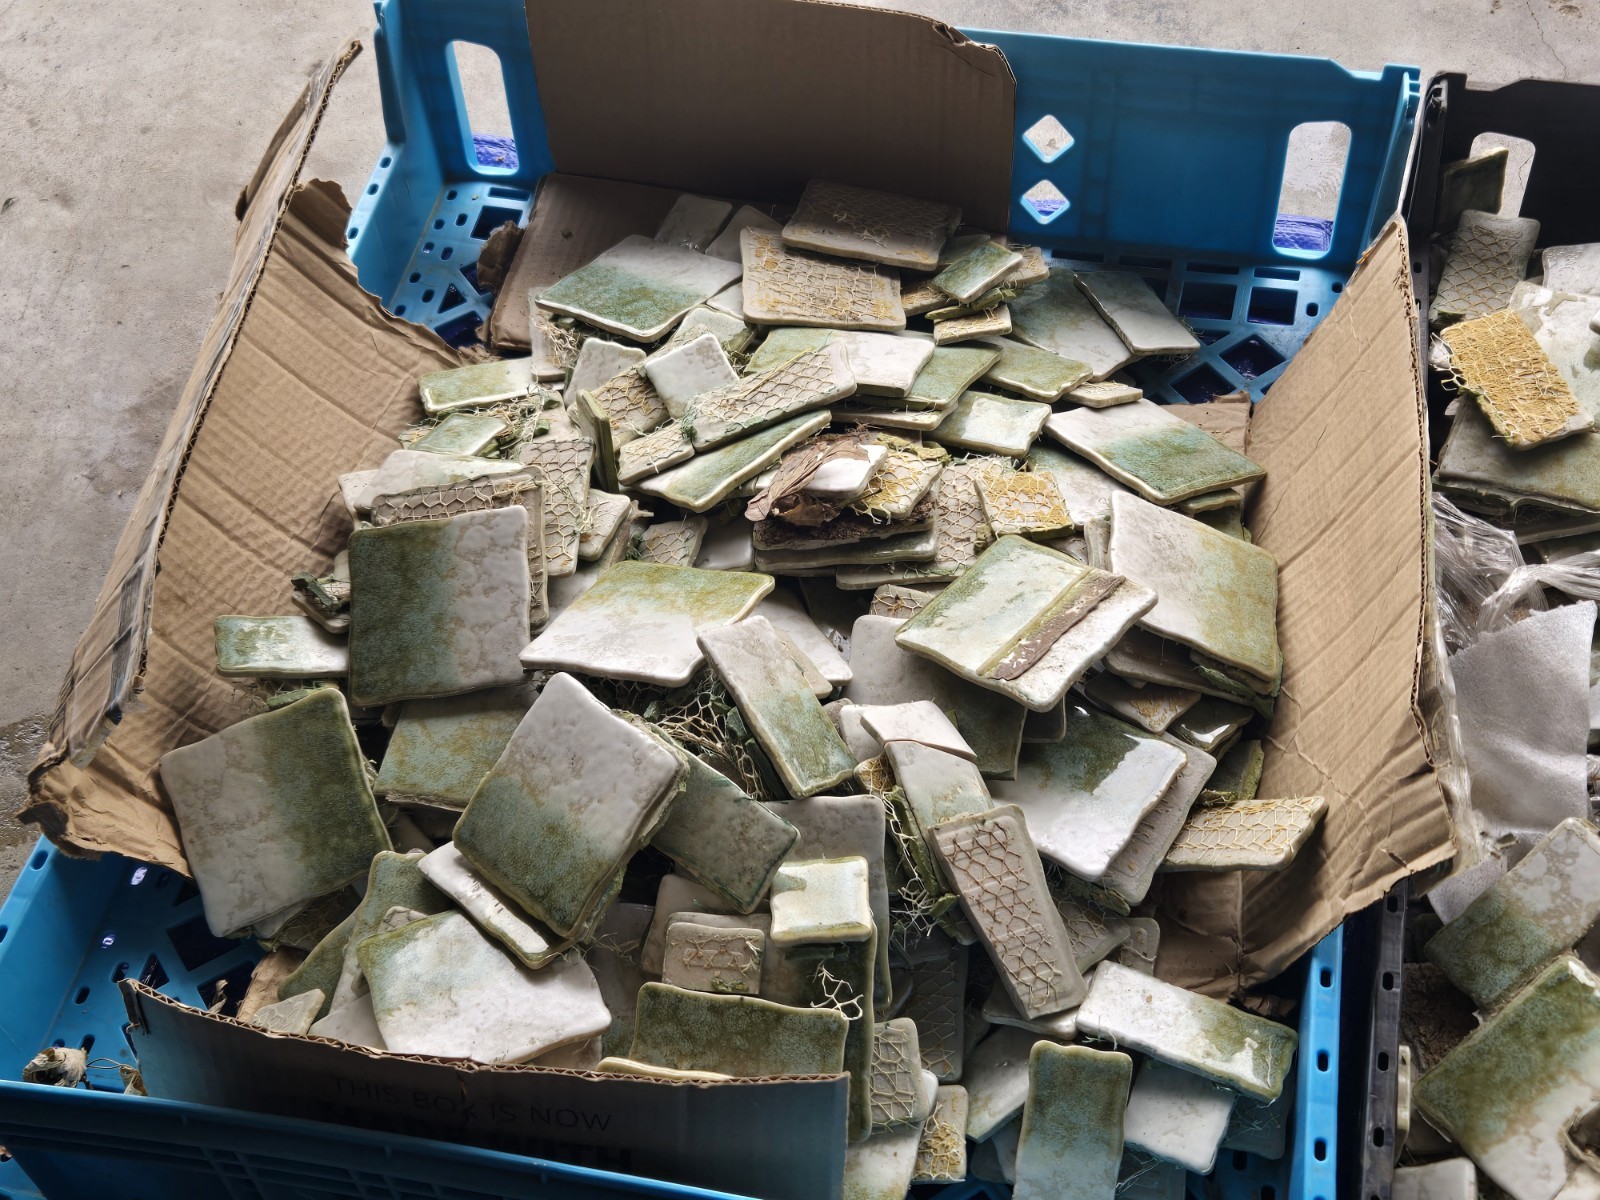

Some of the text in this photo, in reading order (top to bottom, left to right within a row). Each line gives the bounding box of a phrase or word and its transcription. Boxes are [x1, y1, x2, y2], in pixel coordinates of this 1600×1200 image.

[329, 1074, 400, 1104] THIS
[491, 1102, 517, 1122] IS
[530, 1106, 612, 1132] NOW
